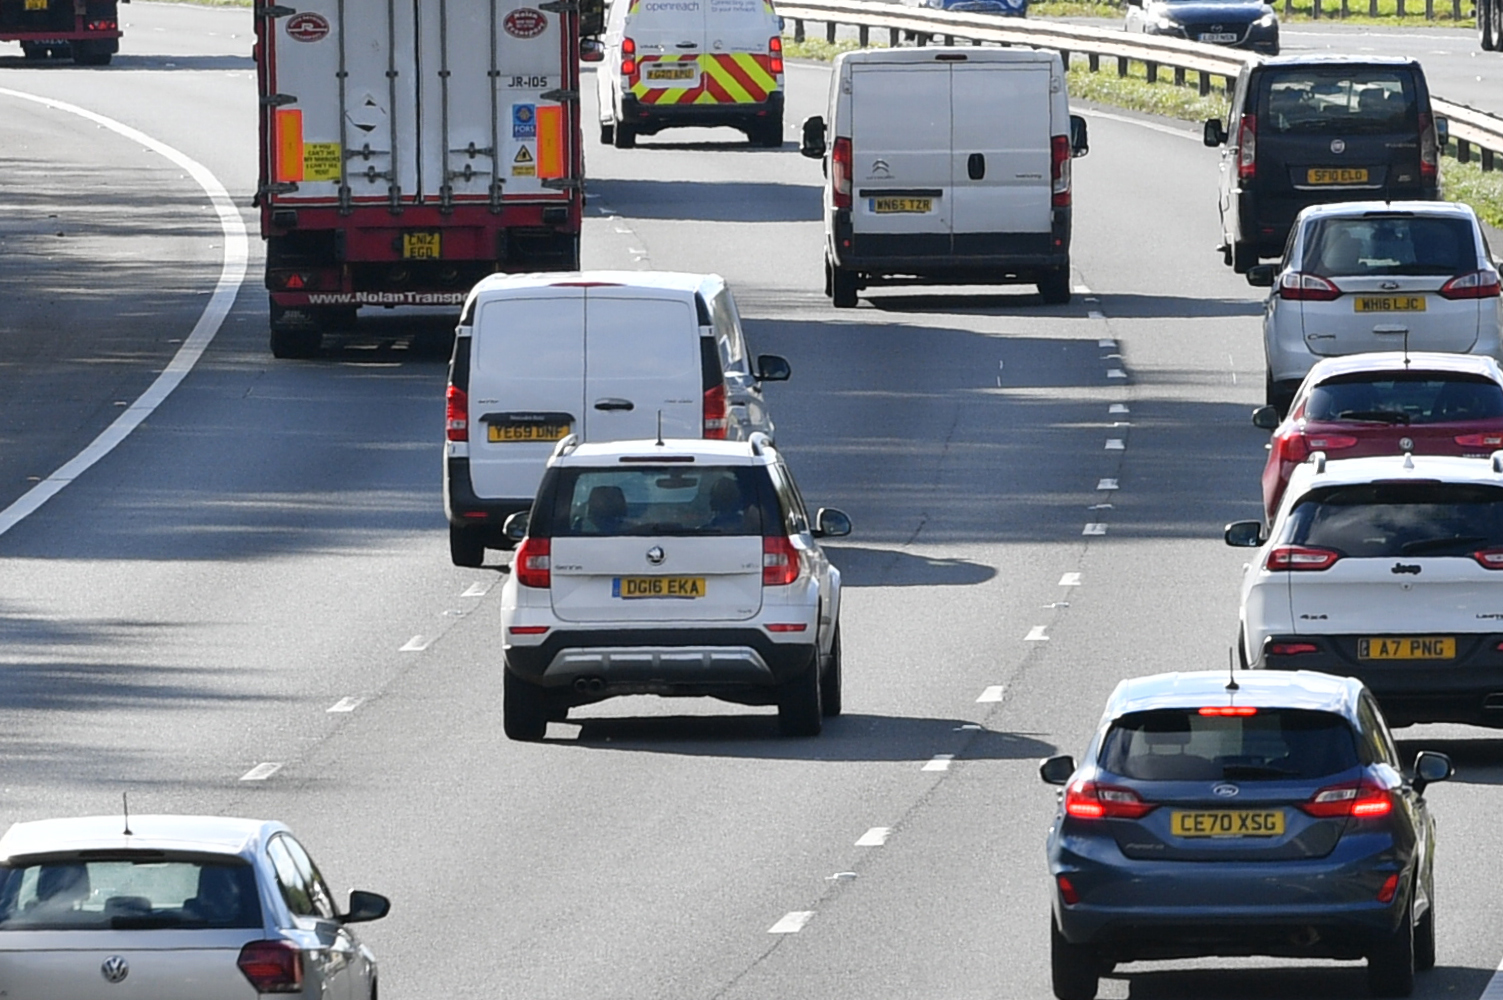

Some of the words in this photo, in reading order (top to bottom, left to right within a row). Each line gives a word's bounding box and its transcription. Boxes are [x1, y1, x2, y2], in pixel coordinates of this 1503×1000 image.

[645, 1, 700, 12] openreach
[514, 125, 535, 133] FORS
[309, 291, 470, 304] www.NolanTranspo
[495, 424, 532, 439] YE69
[1391, 562, 1422, 575] Jeep
[627, 579, 662, 595] DG16
[668, 579, 699, 595] EKA
[1379, 640, 1401, 655] A7
[1410, 640, 1444, 655] PNG
[1181, 813, 1232, 832] CE70
[1238, 813, 1276, 831] XSG
